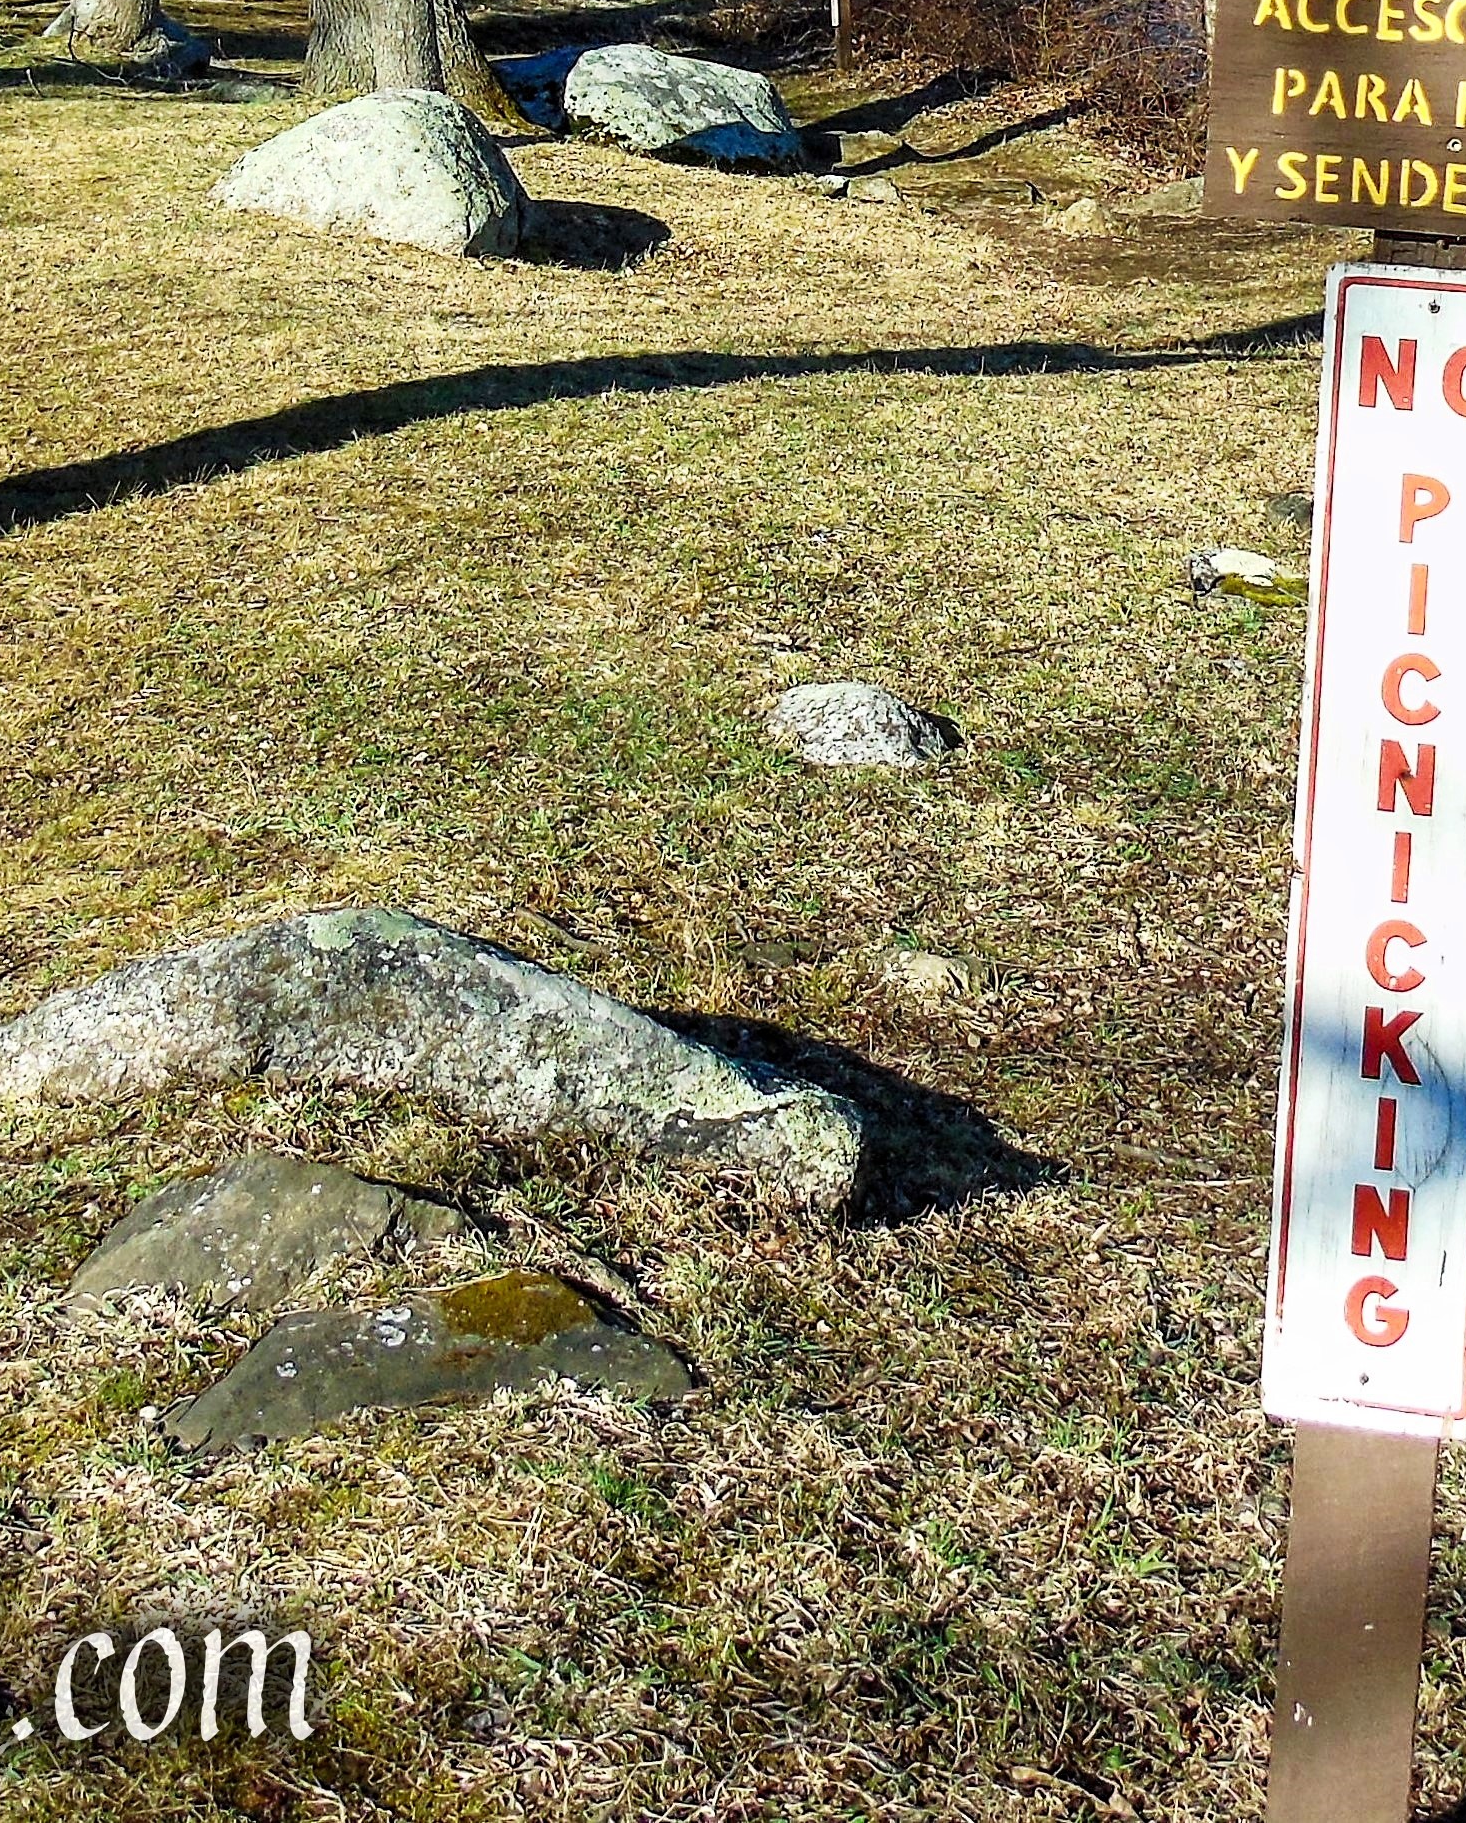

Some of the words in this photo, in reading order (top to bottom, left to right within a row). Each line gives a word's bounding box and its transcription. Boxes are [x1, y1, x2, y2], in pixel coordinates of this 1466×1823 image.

[1271, 67, 1433, 127] PARA
[1225, 146, 1260, 196] Y
[1343, 473, 1452, 1348] PICNICKING
